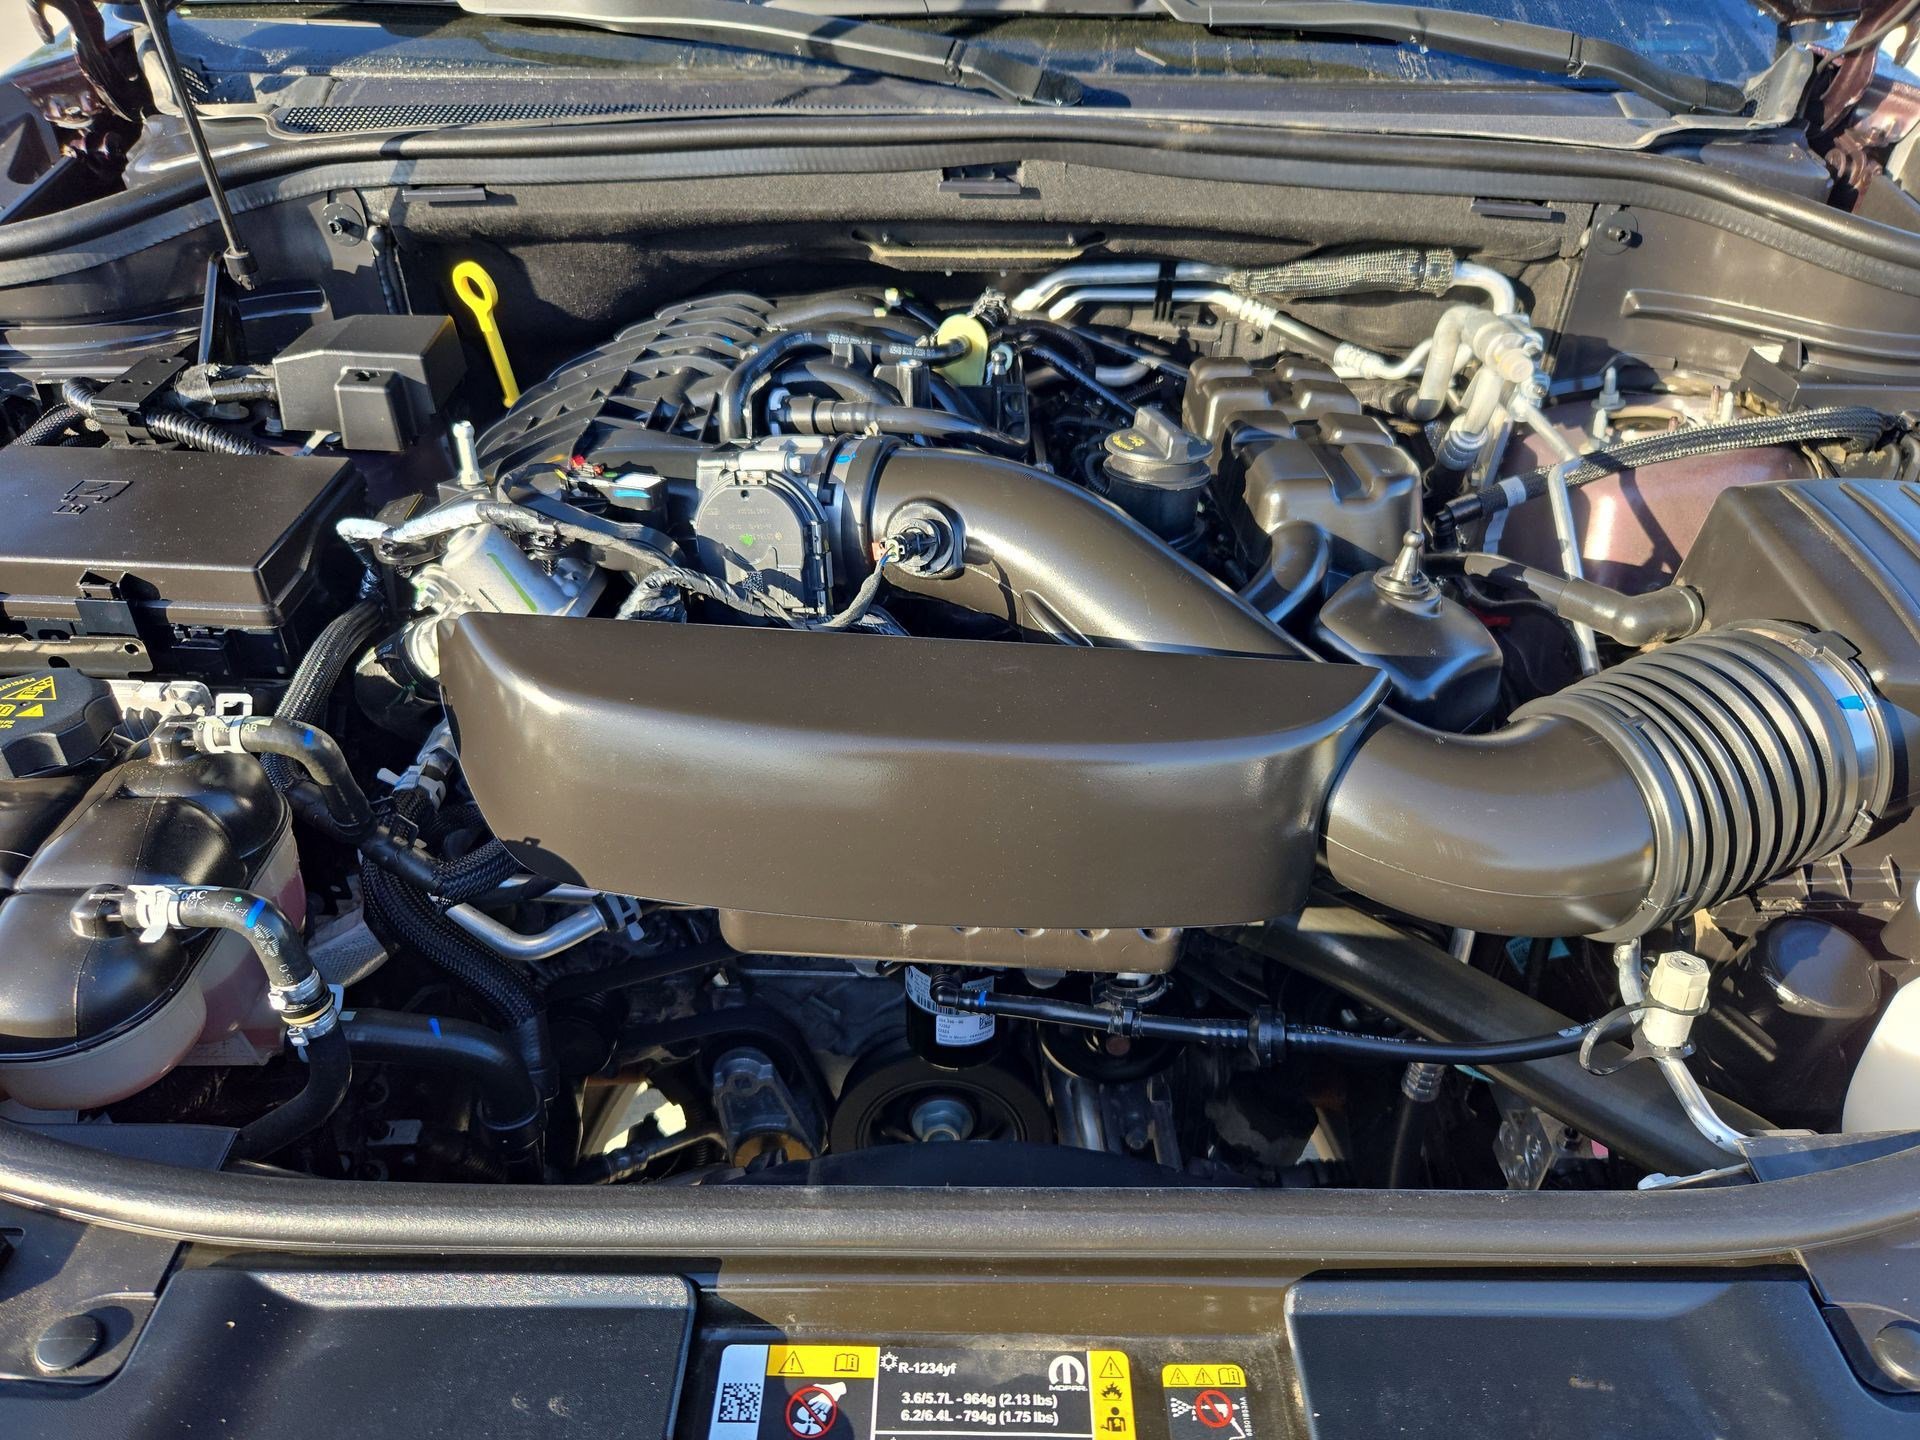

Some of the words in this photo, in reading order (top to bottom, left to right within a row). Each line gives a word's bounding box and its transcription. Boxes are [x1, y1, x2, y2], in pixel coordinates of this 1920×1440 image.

[898, 1362, 957, 1377] R-1234yf
[901, 1392, 954, 1405] 3.6/5.7L
[963, 1392, 997, 1408] 964g
[999, 1393, 1031, 1408] (2.13
[1033, 1394, 1058, 1409] lbs)
[901, 1409, 954, 1422] 6.2/6.4L
[963, 1410, 997, 1425] 794g
[999, 1410, 1031, 1425] (1.75
[1033, 1411, 1059, 1426] lbs)
